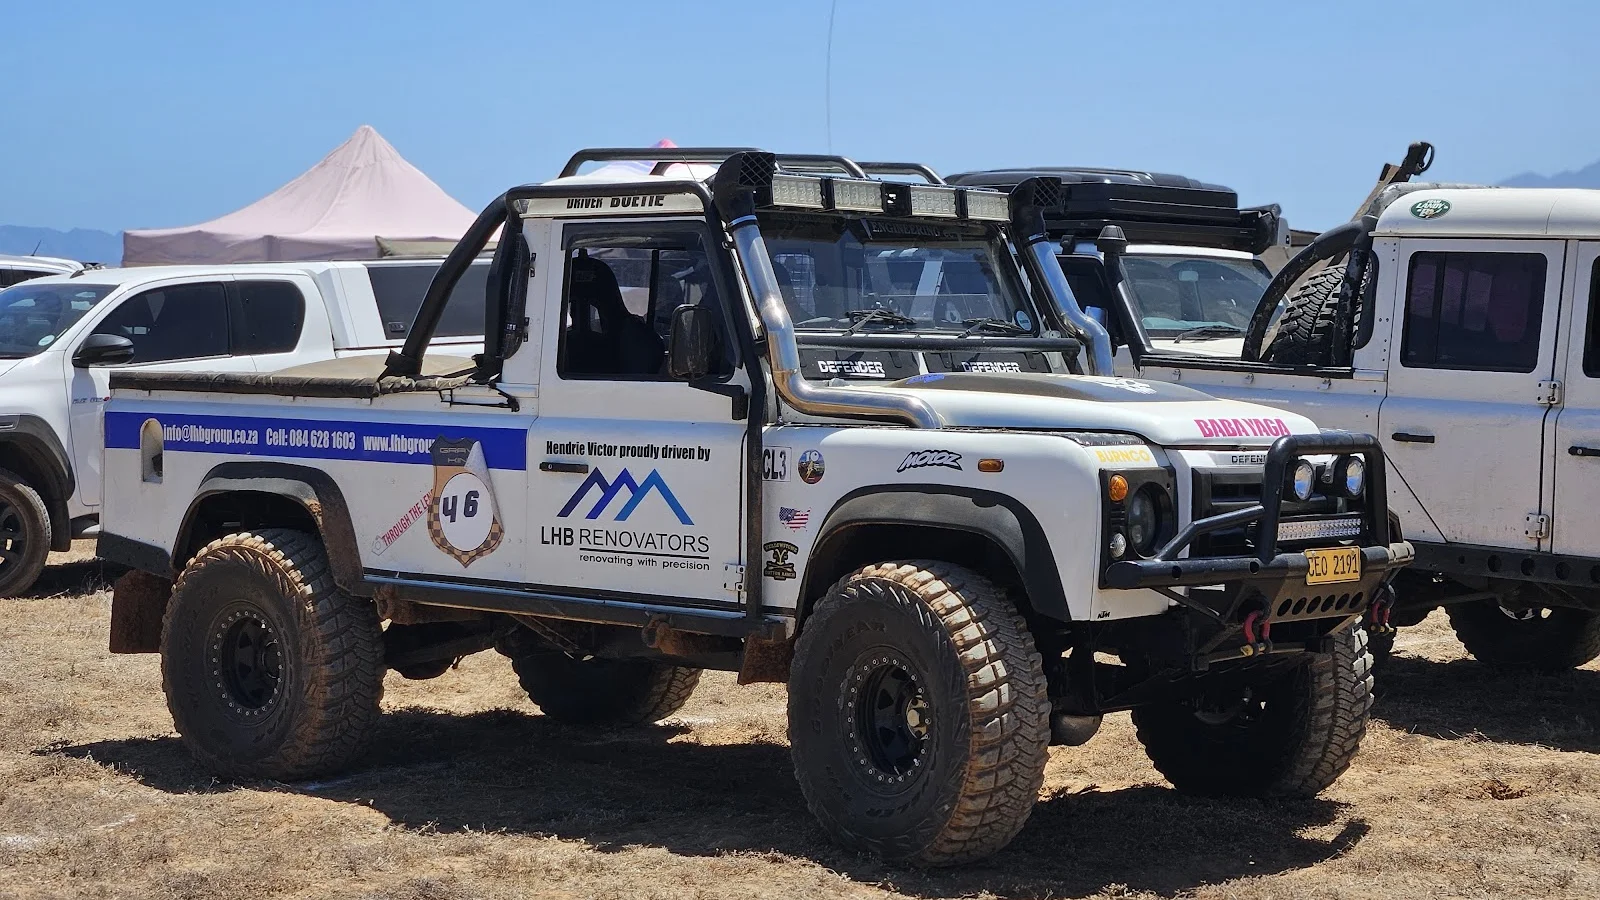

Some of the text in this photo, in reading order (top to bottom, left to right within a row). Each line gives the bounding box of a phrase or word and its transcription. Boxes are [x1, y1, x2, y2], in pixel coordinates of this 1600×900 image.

[817, 360, 886, 373] DEFENDER
[961, 360, 1022, 373] DEFENDER
[1194, 418, 1291, 438] BABA YAGA
[163, 424, 436, 455] info@lhbgroup.co.za Cell: 084 628 1603 www.lhbgrou
[546, 440, 711, 462] Hendrie Victor proudly driven by
[1095, 450, 1151, 463] BURNCO
[762, 448, 787, 480] CL3
[381, 513, 411, 547] THROUGH
[409, 502, 423, 521] THE
[541, 526, 710, 553] LHB RENOVATORS
[579, 553, 710, 570] renovating with precision
[1333, 554, 1359, 575] 2191
